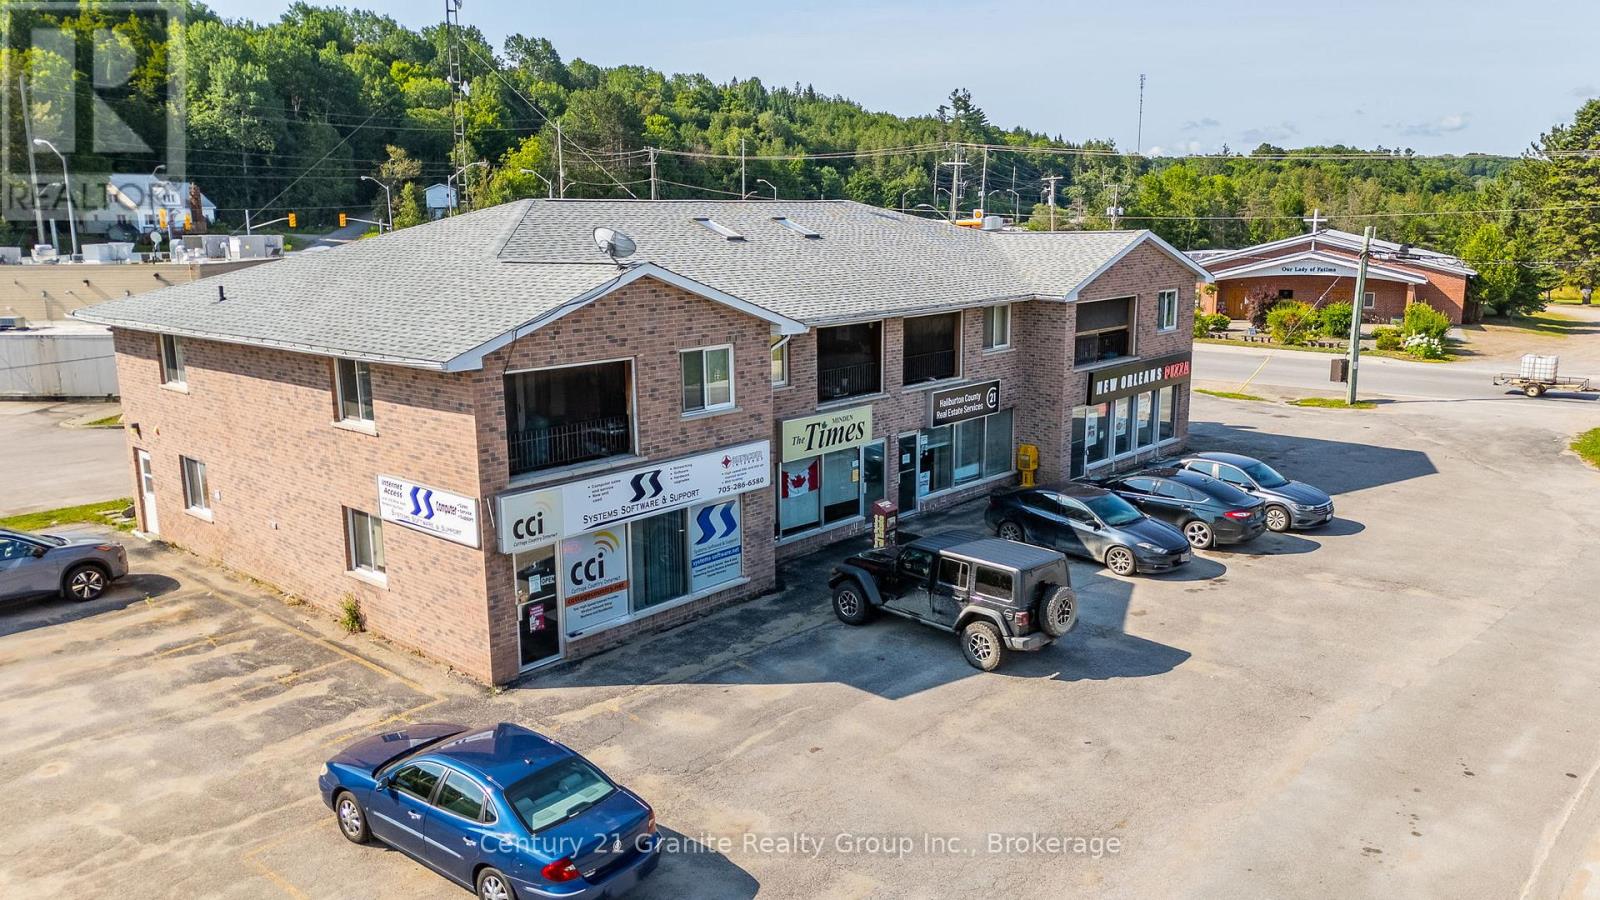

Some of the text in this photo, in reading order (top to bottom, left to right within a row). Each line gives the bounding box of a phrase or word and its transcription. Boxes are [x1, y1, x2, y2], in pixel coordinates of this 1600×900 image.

[1096, 362, 1190, 396] NEW ORLEANS PIZZA
[940, 393, 982, 408] Haliburton County
[936, 402, 984, 420] Real Estate Services
[832, 414, 854, 424] MINDEN
[792, 420, 865, 452] The Times
[382, 480, 403, 490] Internet
[718, 476, 764, 494] 705-286-6580
[384, 488, 403, 498] Access
[662, 495, 668, 504] &
[541, 576, 555, 585] OPEN
